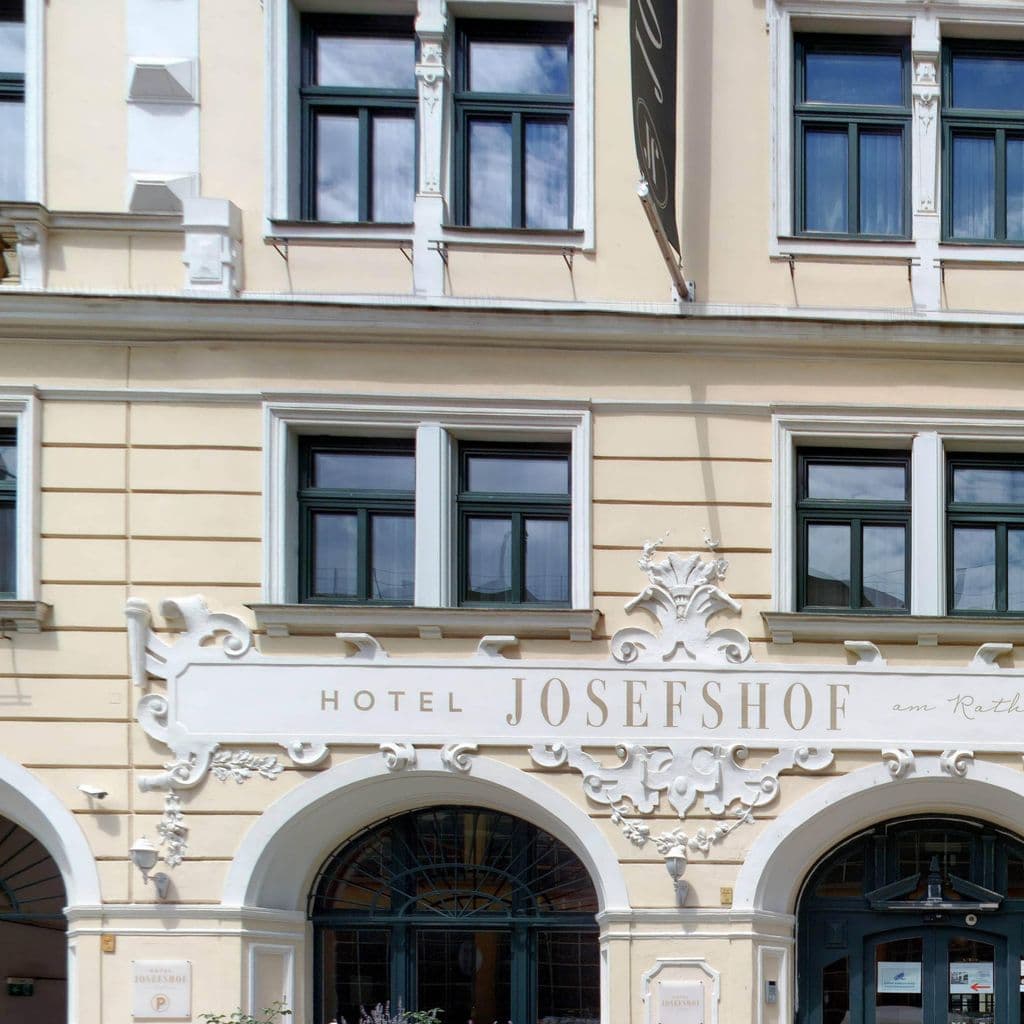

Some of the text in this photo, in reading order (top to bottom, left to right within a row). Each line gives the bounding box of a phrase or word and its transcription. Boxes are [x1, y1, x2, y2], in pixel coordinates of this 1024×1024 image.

[320, 677, 851, 732] HOTEL JOSEFSHOF
[892, 702, 937, 712] am
[156, 996, 166, 1011] P
